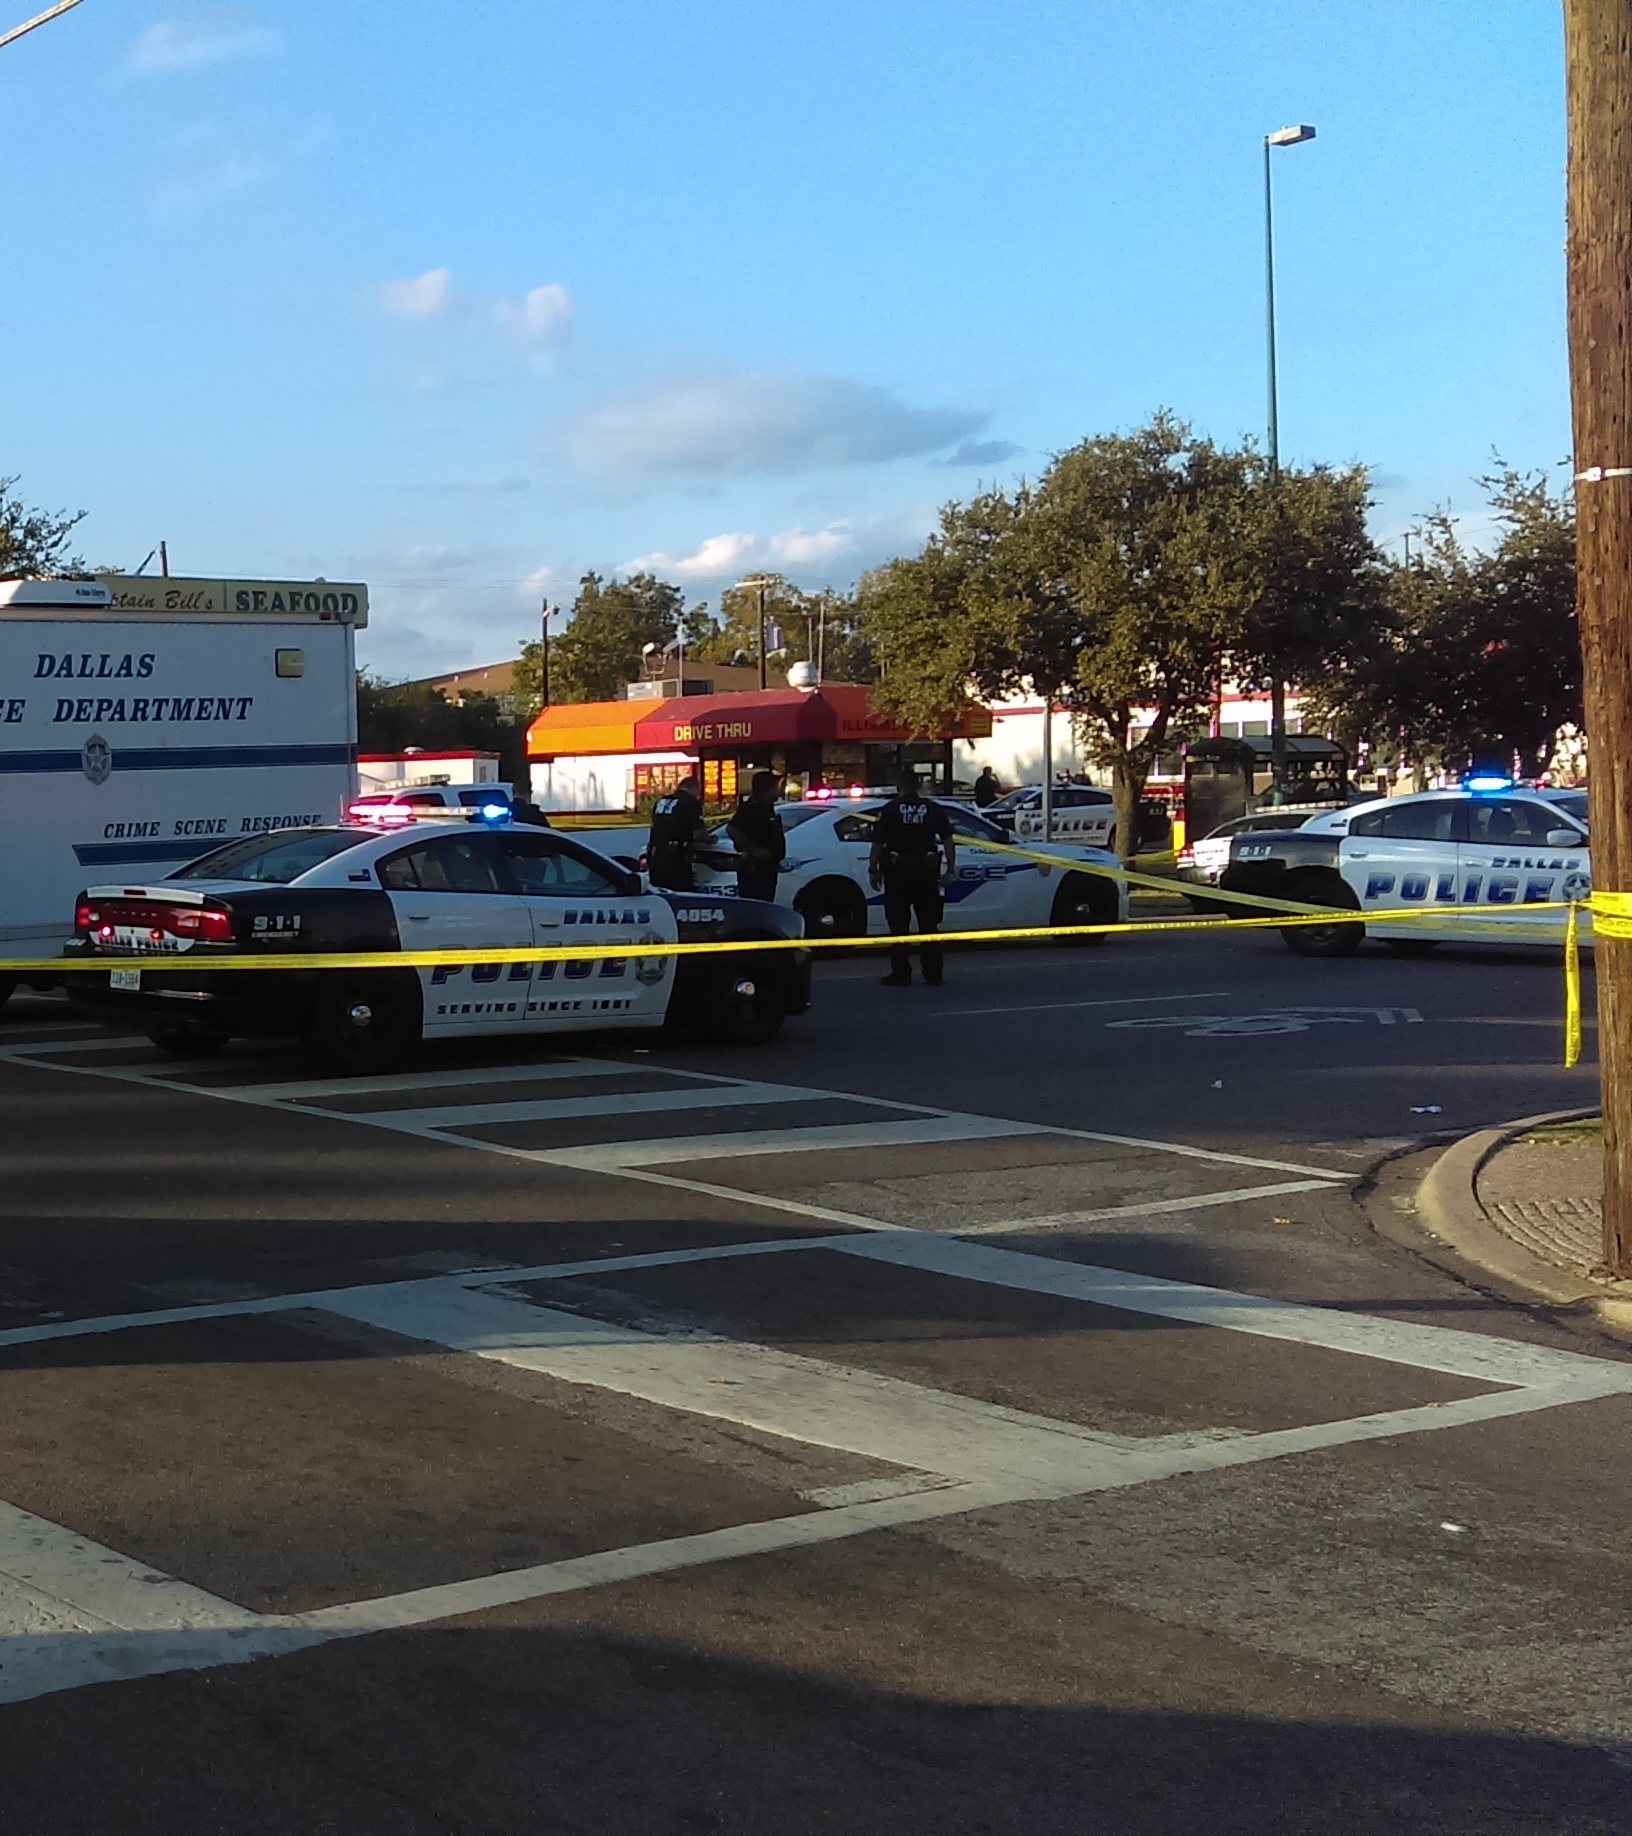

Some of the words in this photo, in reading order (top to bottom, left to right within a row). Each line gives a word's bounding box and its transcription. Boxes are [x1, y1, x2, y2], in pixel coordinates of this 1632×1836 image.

[165, 590, 214, 610] Bill's
[235, 590, 359, 614] SEAFOOD
[34, 653, 156, 678] DALLAS
[53, 697, 253, 723] DEPARTMENT
[674, 725, 713, 742] DRIVE
[716, 722, 752, 738] THRU
[103, 821, 161, 839] CRIME
[173, 818, 228, 836] SCENE
[240, 814, 322, 832] RESPONSE
[1490, 856, 1582, 870] DALLAS
[1364, 872, 1555, 904] POLICE
[563, 908, 652, 925] DALLAS
[676, 909, 725, 922] 4054
[430, 938, 632, 985] POLICE
[437, 1003, 518, 1015] SERVING
[527, 1000, 583, 1012] SINCE
